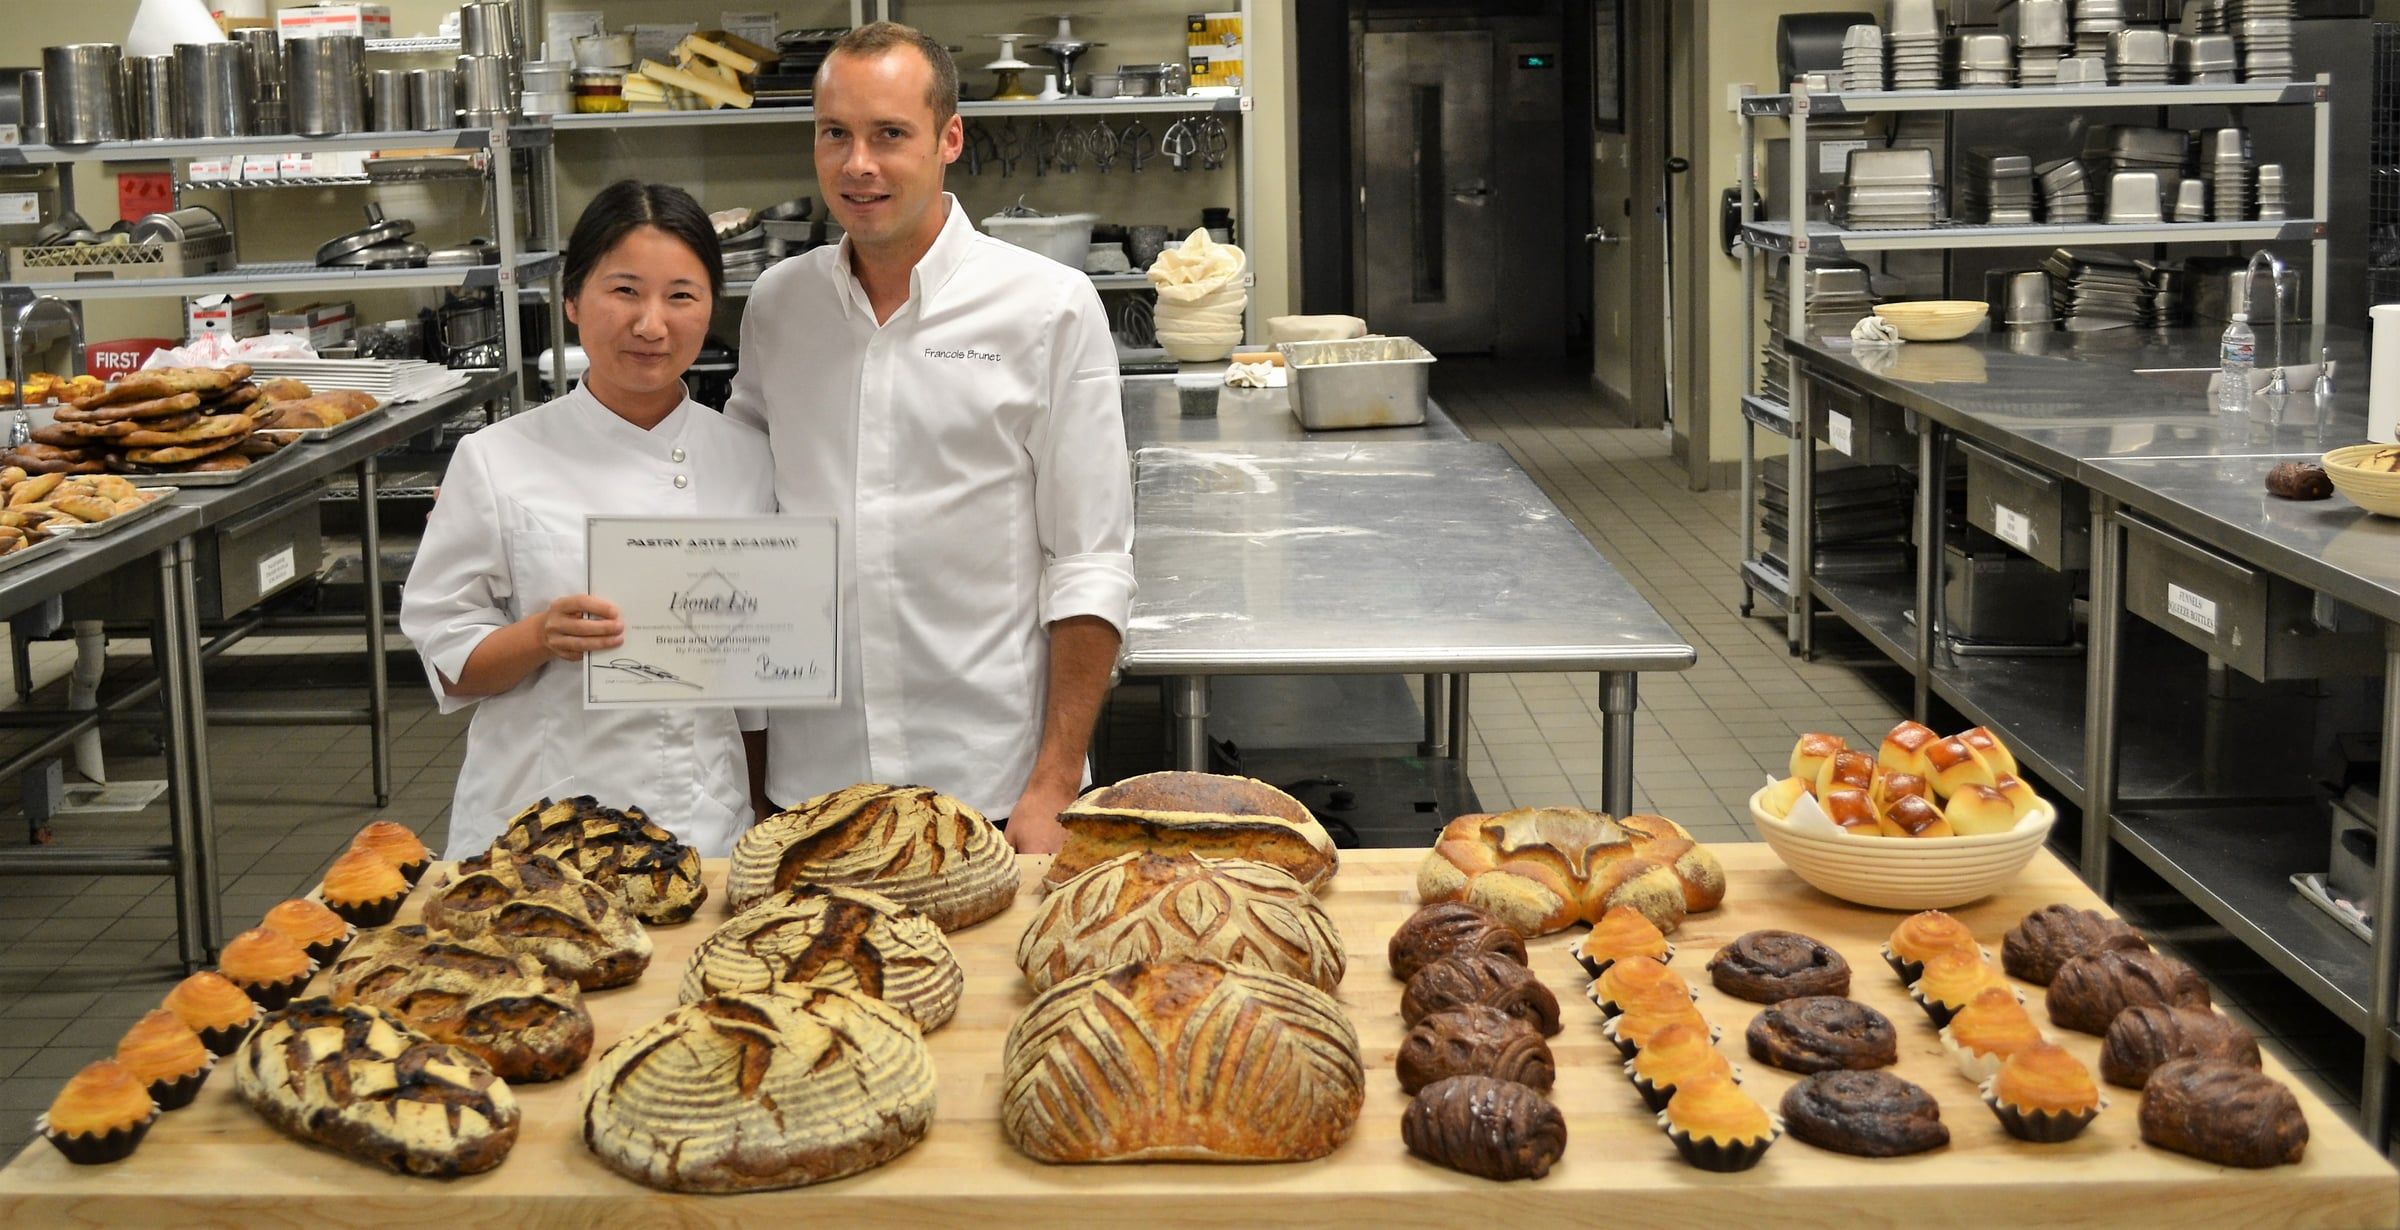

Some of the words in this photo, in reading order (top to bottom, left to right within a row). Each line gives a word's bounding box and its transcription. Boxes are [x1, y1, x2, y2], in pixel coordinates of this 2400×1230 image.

[96, 351, 140, 369] FIRST
[967, 349, 1001, 361] Brunet
[626, 538, 681, 547] PASTRY
[686, 538, 728, 547] ARTS
[656, 635, 686, 644] Bread
[689, 635, 707, 644] and
